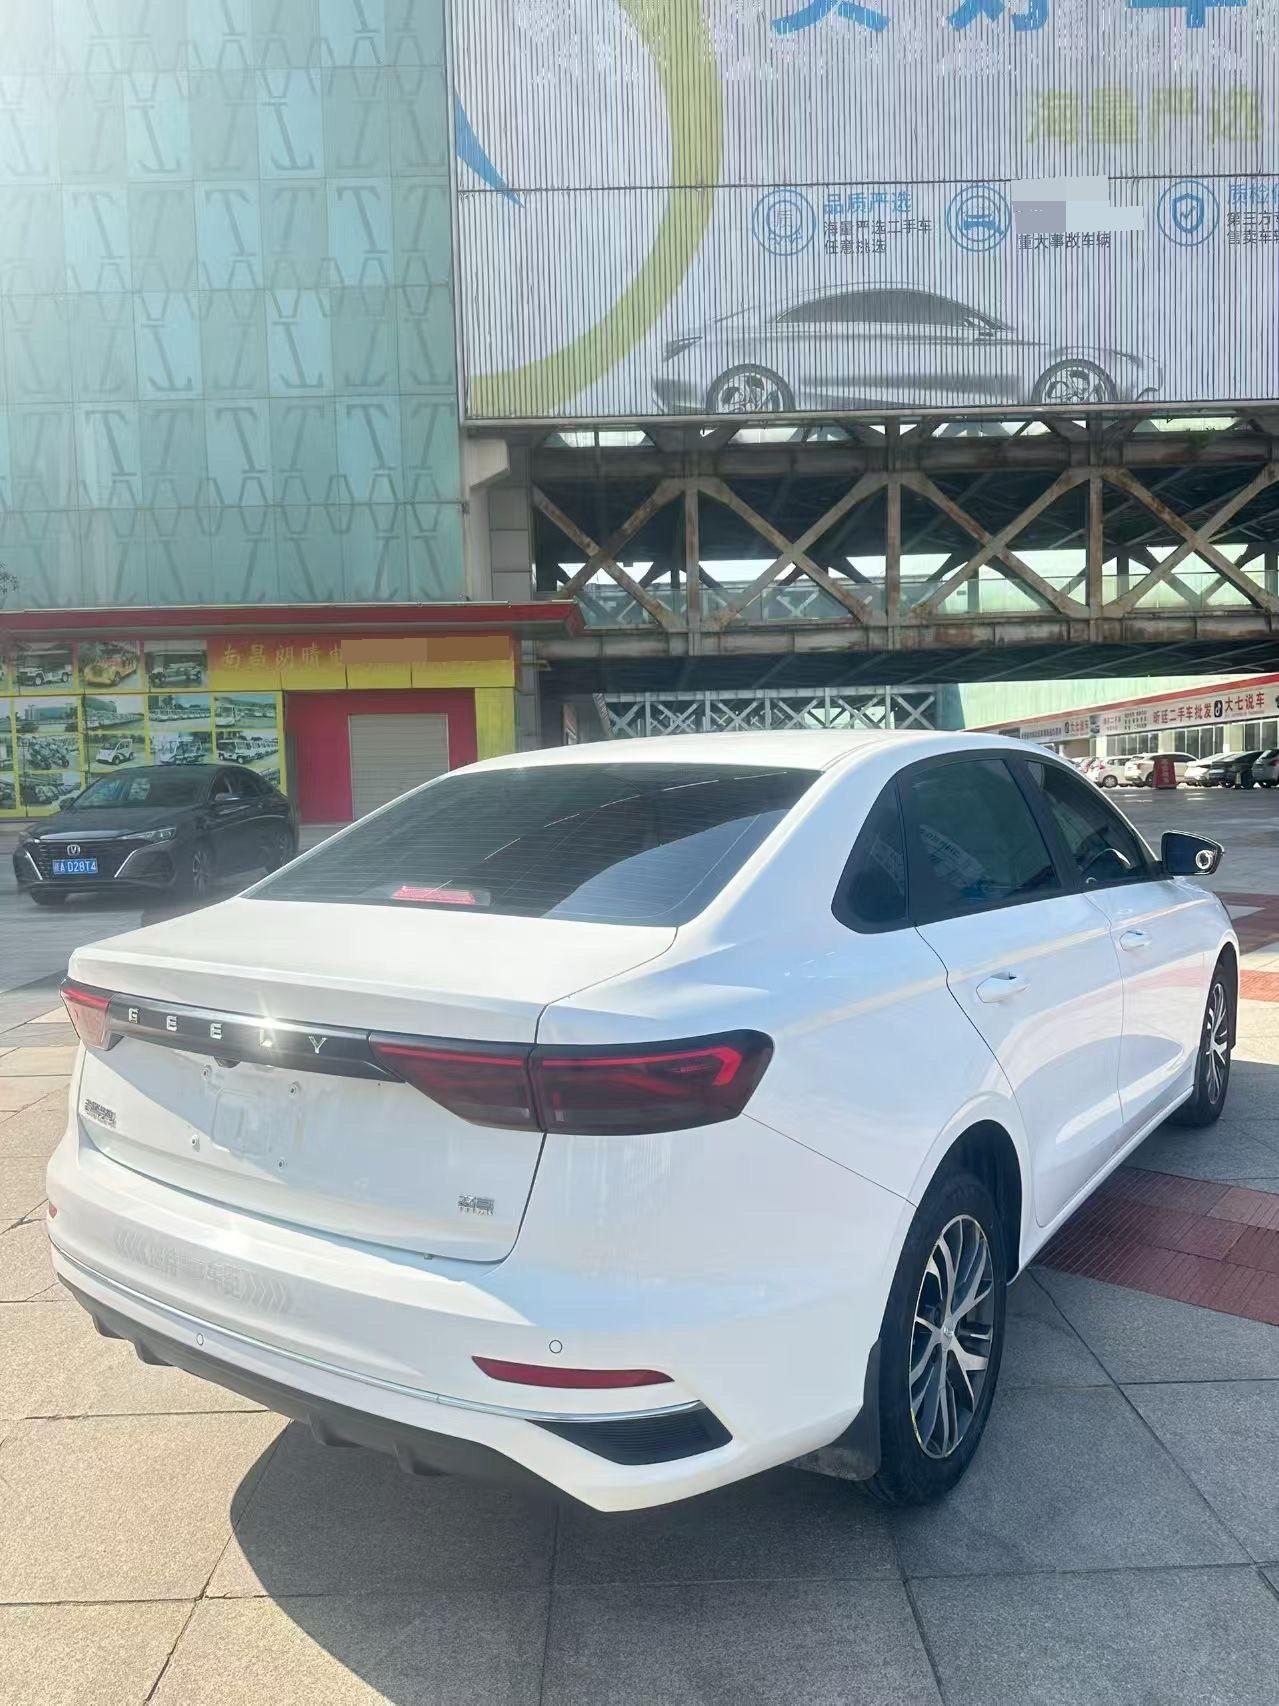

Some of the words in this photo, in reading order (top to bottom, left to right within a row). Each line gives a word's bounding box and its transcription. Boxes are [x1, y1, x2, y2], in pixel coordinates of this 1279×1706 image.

[824, 191, 912, 216] 品质严选
[823, 219, 933, 236] 海量严选二手车
[824, 238, 887, 255] 任意挑选
[1018, 233, 1112, 250] 重大事故车辆
[1225, 692, 1264, 713] 大七说车
[128, 1007, 328, 1054] GEELY
